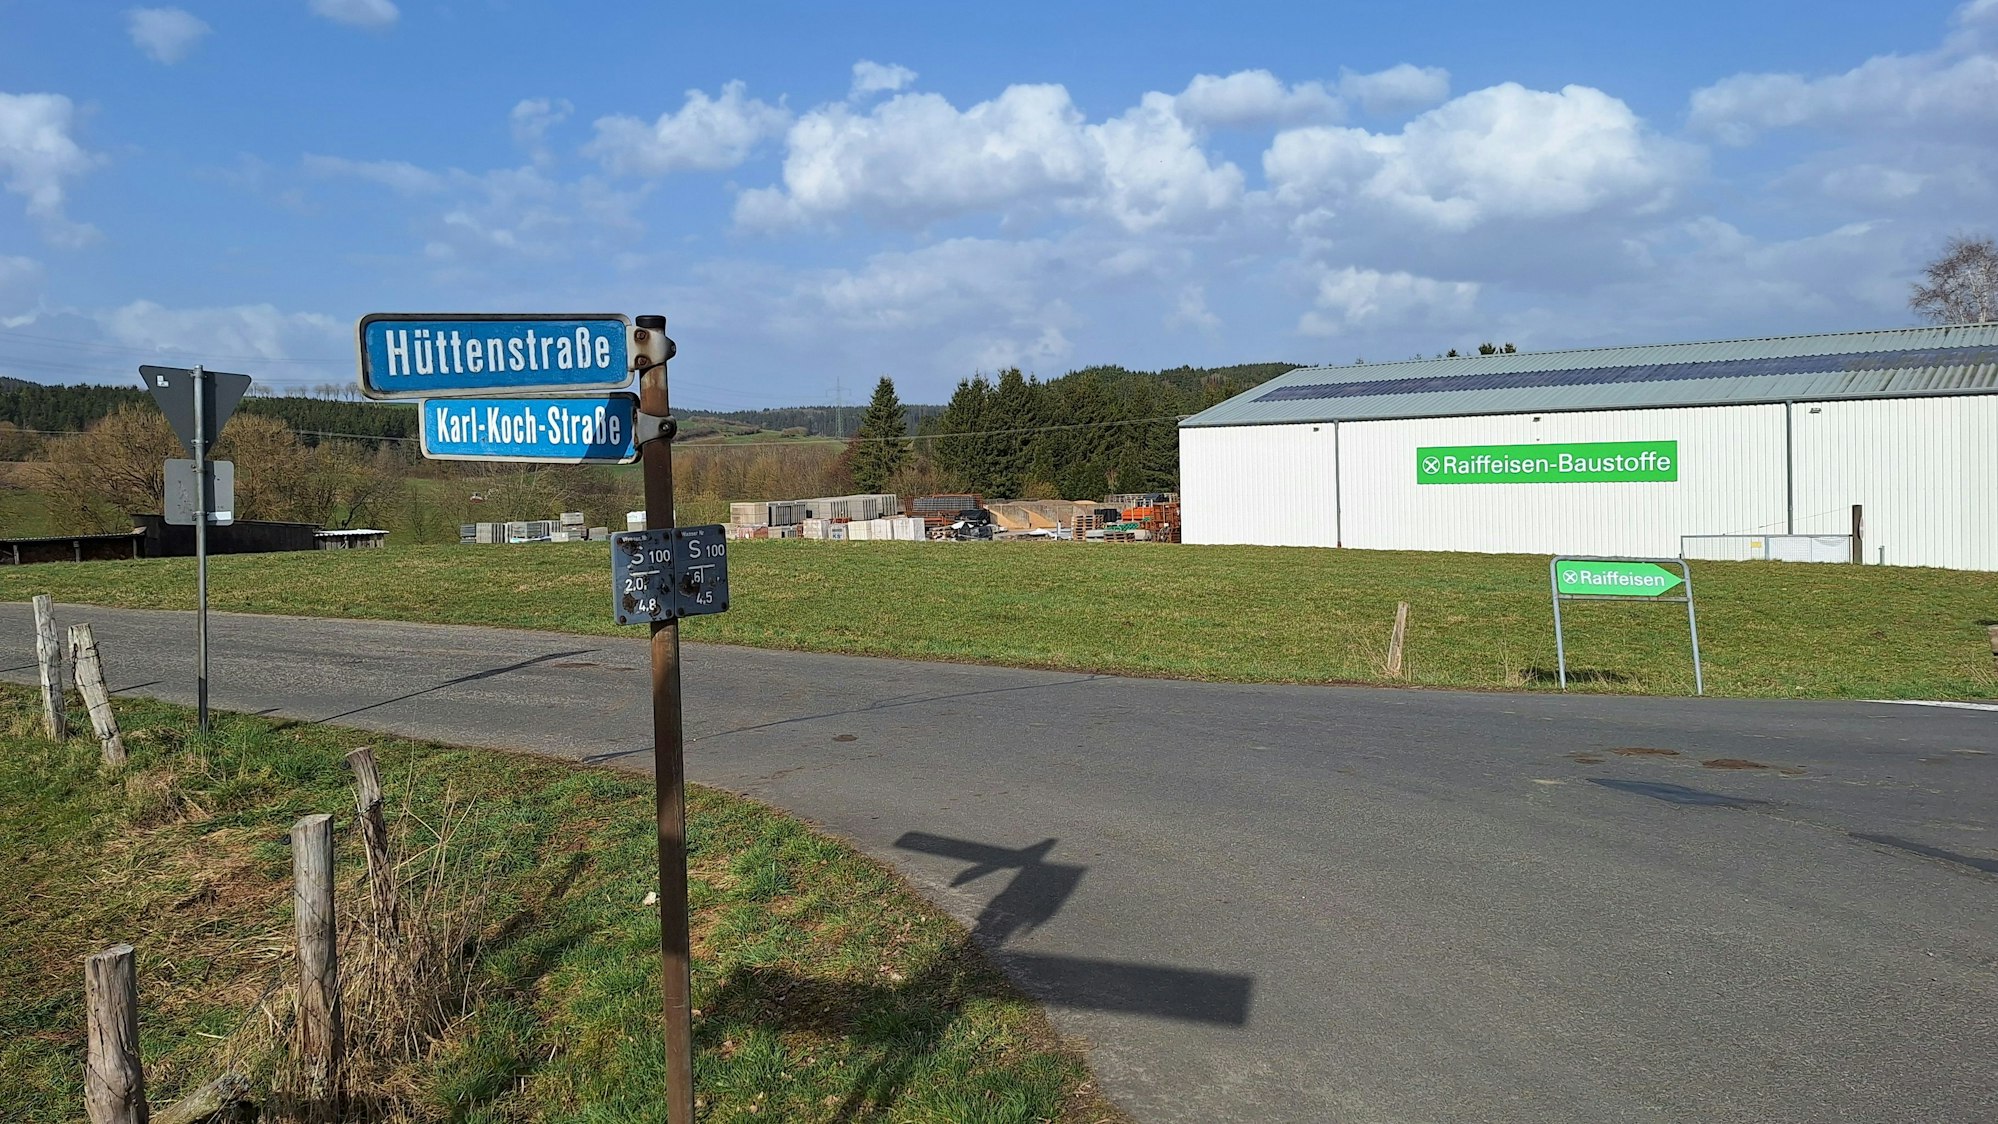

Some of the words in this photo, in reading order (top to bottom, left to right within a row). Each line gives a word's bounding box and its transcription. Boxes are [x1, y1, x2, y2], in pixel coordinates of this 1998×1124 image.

[385, 326, 611, 377] Hüttenstraße
[436, 405, 621, 446] Karl-Koch-Straße
[1443, 451, 1672, 475] Raiffeisen-Baustoffe
[649, 549, 671, 564] 100
[688, 539, 701, 559] S
[706, 544, 725, 558] 100
[1579, 569, 1665, 587] Raiffeisen
[638, 598, 657, 612] 4,8
[696, 591, 713, 606] 4,5
